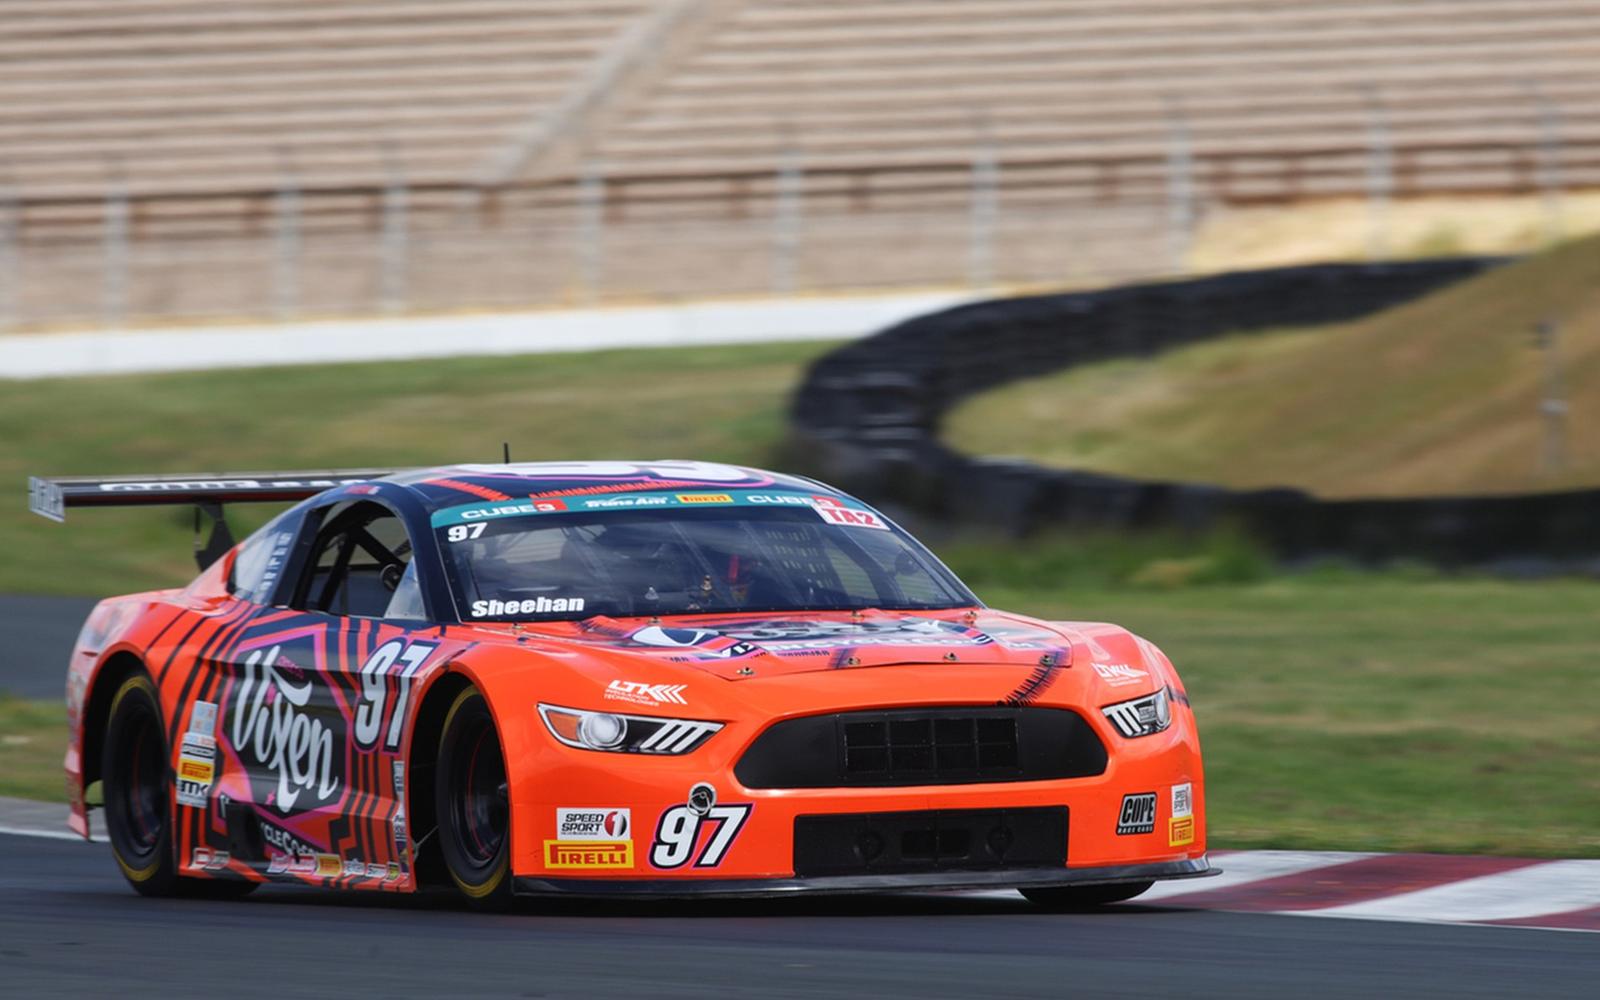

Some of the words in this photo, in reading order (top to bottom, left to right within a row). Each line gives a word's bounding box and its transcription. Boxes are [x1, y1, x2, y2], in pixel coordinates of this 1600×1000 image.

[461, 503, 556, 520] CUBE3
[821, 507, 881, 526] TA2
[448, 522, 488, 543] 97
[471, 596, 584, 617] Sheehan
[355, 641, 434, 748] 97
[233, 645, 339, 813] Vixen
[565, 813, 604, 823] SPEED
[1121, 797, 1155, 823] COPE
[561, 823, 603, 832] SPORT
[653, 805, 749, 867] 97
[550, 844, 627, 864] PIRELLI
